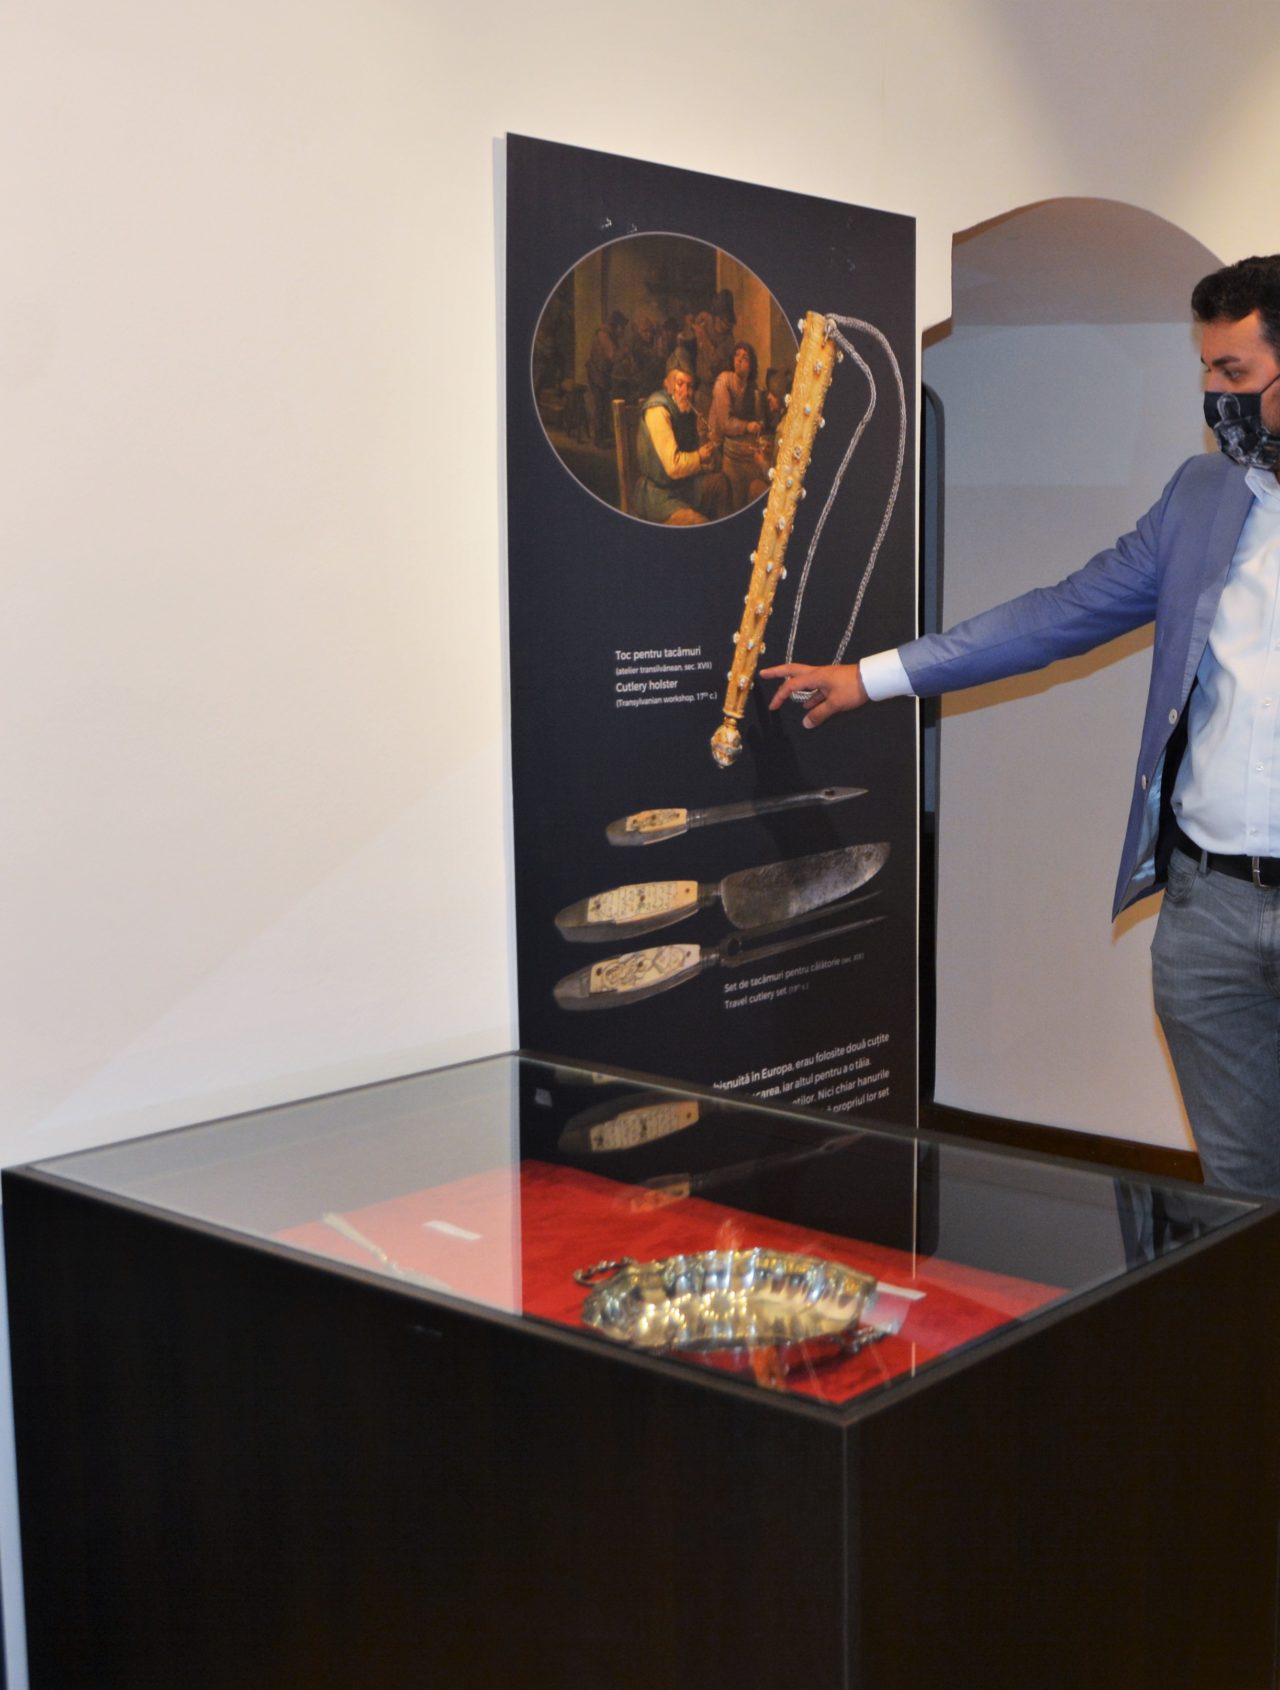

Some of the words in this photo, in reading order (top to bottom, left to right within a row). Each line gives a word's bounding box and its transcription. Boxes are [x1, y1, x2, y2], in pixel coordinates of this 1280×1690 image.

[615, 650, 631, 660] Toc
[633, 650, 662, 661] pentru
[616, 681, 647, 693] Cutlery
[649, 679, 678, 690] holster
[724, 983, 737, 993] Set
[739, 979, 749, 990] de
[785, 965, 809, 979] pentru
[725, 996, 748, 1009] Travel
[749, 990, 774, 1004] cutlery
[776, 987, 787, 997] set
[751, 1071, 760, 1082] în
[761, 1064, 795, 1079] Europa,
[795, 1056, 814, 1069] erau
[816, 1047, 845, 1064] folosite
[846, 1038, 866, 1054] două
[867, 1033, 890, 1048] cuțite
[783, 1082, 794, 1092] iar
[795, 1074, 813, 1089] altul
[815, 1068, 842, 1085] pentru
[843, 1065, 848, 1073] a
[849, 1063, 854, 1072] o
[818, 1085, 834, 1100] Nici
[835, 1080, 856, 1094] chiar
[857, 1069, 890, 1086] hanurile
[866, 1092, 877, 1103] lor
[879, 1087, 890, 1098] set
